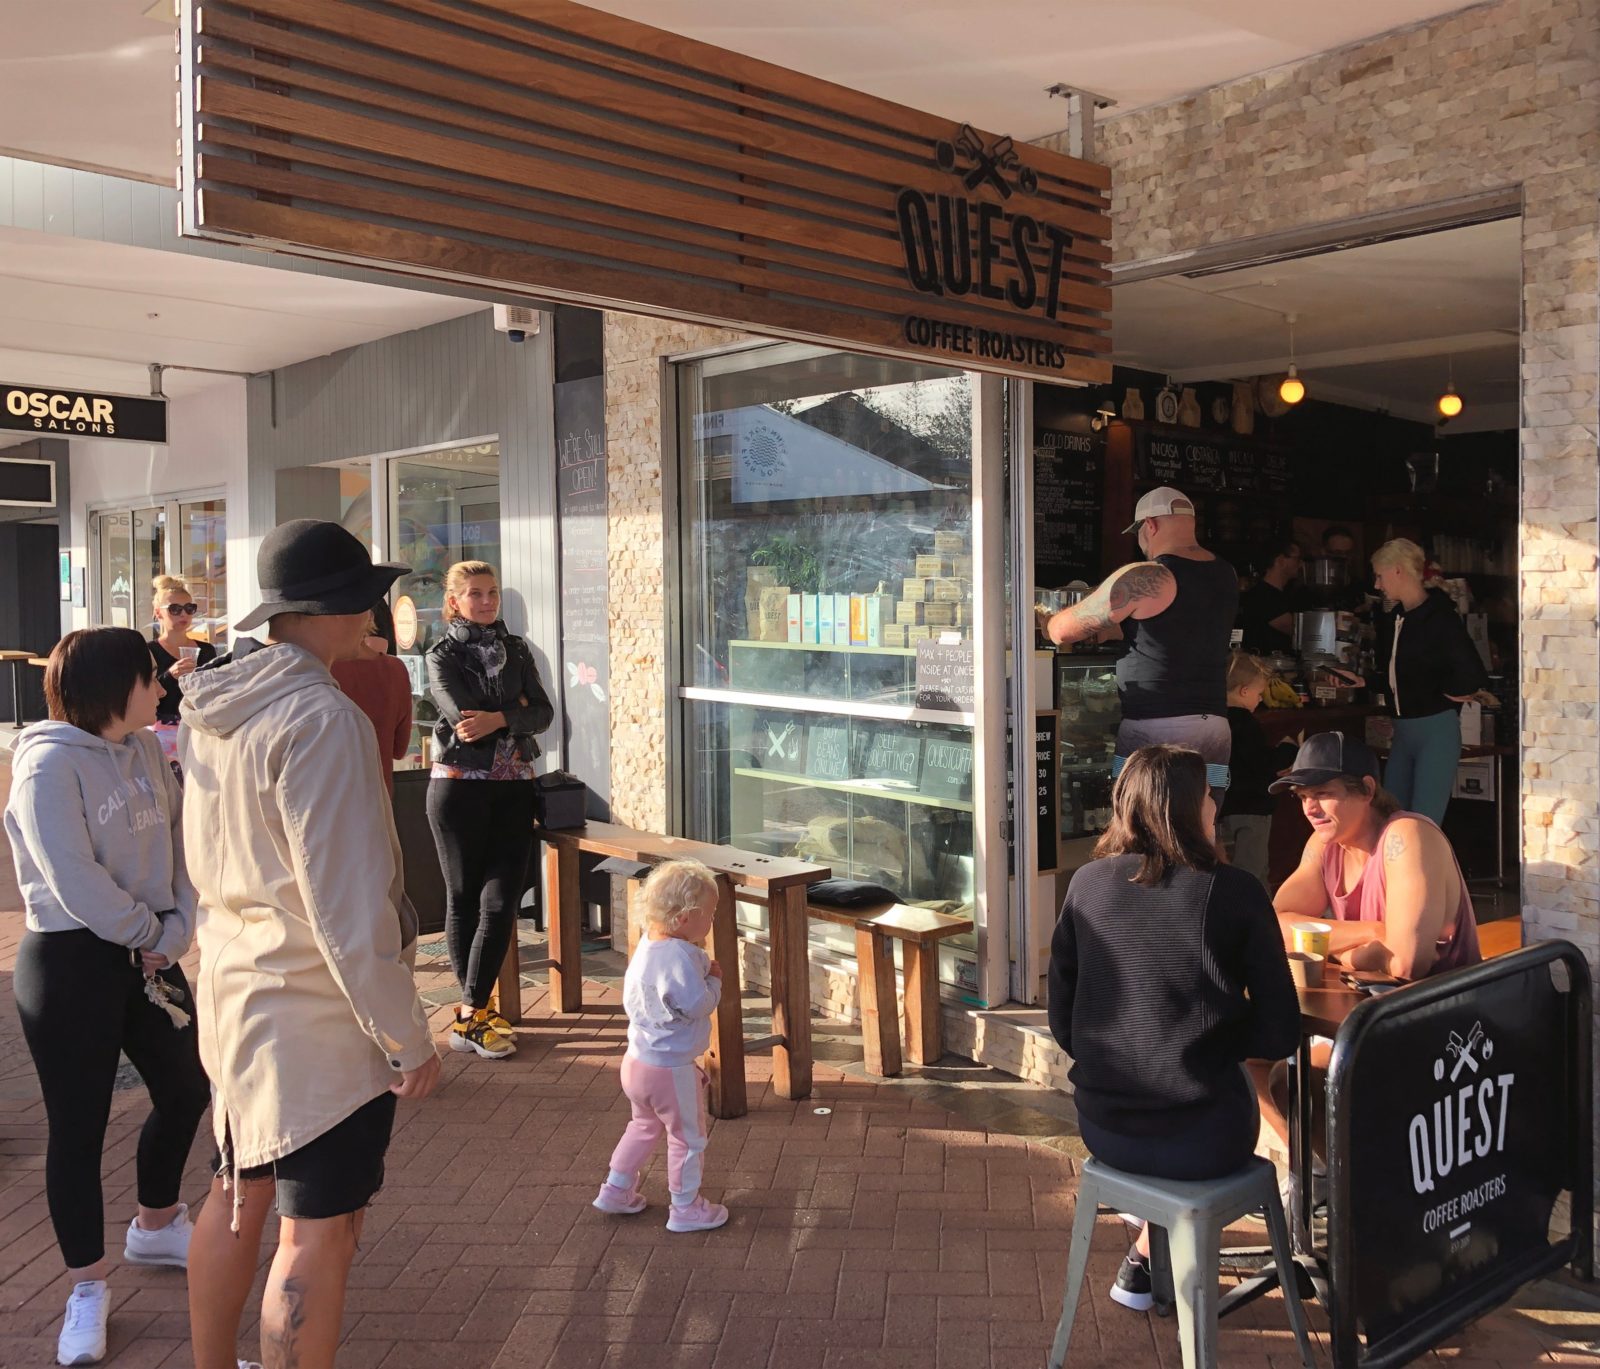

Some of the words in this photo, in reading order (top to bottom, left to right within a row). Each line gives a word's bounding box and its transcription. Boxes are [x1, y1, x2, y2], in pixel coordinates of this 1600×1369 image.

[897, 188, 1074, 320] QUEST
[905, 315, 973, 354] COFFEE
[978, 328, 1066, 368] ROASTERS
[7, 391, 114, 424] OSCAR
[34, 419, 115, 434] SALONS
[1043, 433, 1063, 448] COLD
[1064, 435, 1091, 452] DRINKS
[919, 648, 935, 661] MAX
[945, 650, 974, 663] PEOPLE
[943, 665, 952, 676] AT
[953, 665, 974, 676] ONCE
[919, 684, 939, 693] PLEASE
[941, 685, 953, 693] WAIT
[955, 686, 974, 695] OUTSID
[919, 694, 931, 702] FOR
[935, 694, 951, 703] YOUR
[816, 741, 840, 759] BEANS
[878, 732, 897, 750] SELF
[1038, 769, 1046, 778] 30
[1038, 786, 1047, 796] 25
[1409, 1073, 1514, 1194] QUEST
[1423, 1197, 1459, 1233] COFFEE
[1460, 1174, 1506, 1215] ROASTERS
